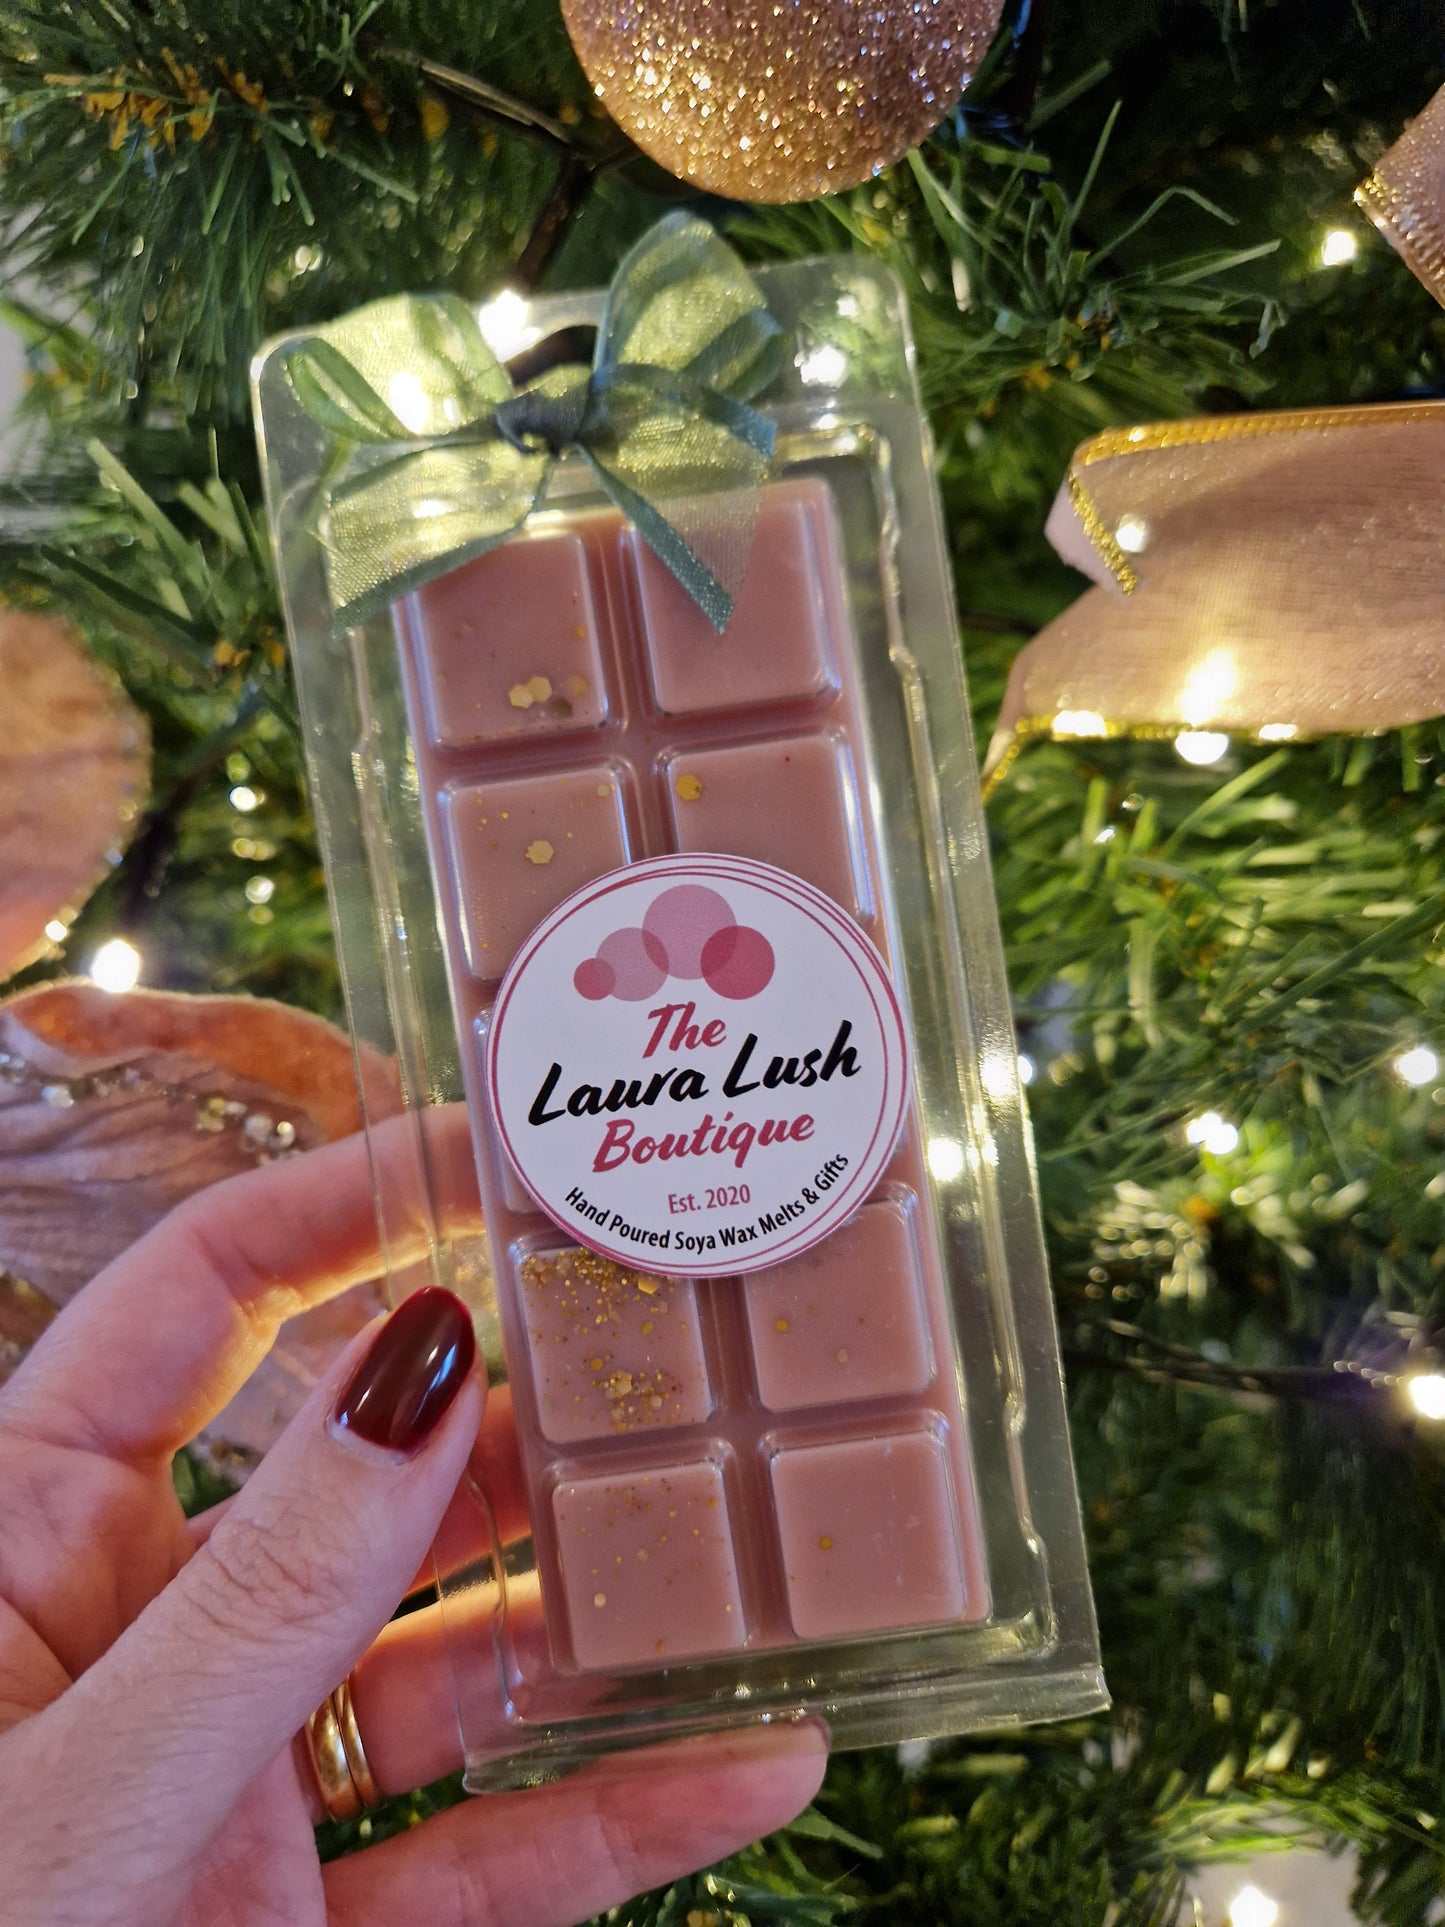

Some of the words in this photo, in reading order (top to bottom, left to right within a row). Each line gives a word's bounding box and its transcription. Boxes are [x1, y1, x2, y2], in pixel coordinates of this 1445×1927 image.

[642, 1001, 727, 1059] The
[528, 1062, 709, 1126] Laura
[722, 1019, 862, 1098] Lush
[592, 1111, 815, 1173] Boutique
[564, 1187, 610, 1227] Hand
[608, 1215, 671, 1249] Poured
[674, 1231, 716, 1255] Soya
[718, 1224, 760, 1249] Wax
[760, 1198, 805, 1235] Melts
[803, 1187, 820, 1206] &
[814, 1153, 849, 1191] Gifts
[668, 1193, 701, 1214] Est.
[705, 1184, 751, 1209] 2020
